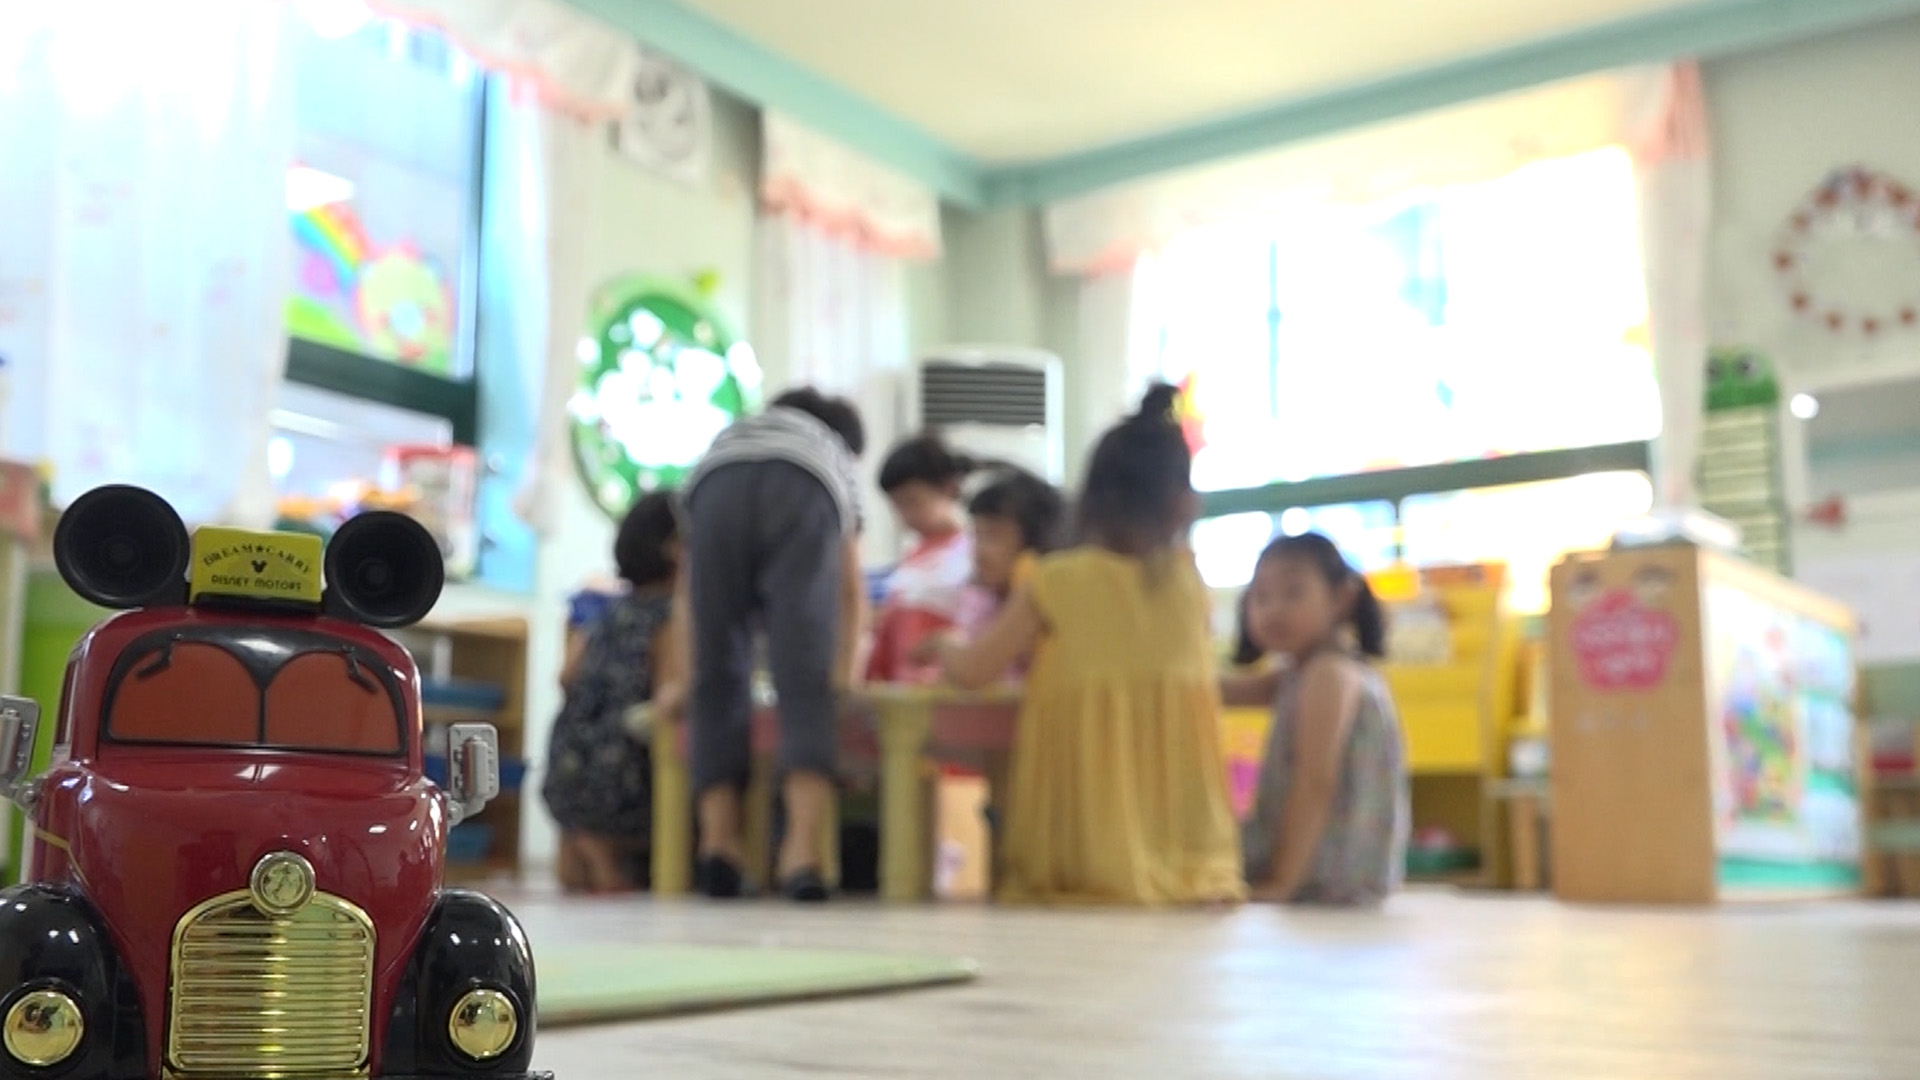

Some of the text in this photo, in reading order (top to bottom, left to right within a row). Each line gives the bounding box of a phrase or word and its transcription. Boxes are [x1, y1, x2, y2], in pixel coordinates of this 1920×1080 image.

[203, 543, 253, 567] DREAM
[211, 575, 302, 592] DISNEY MOTORS
